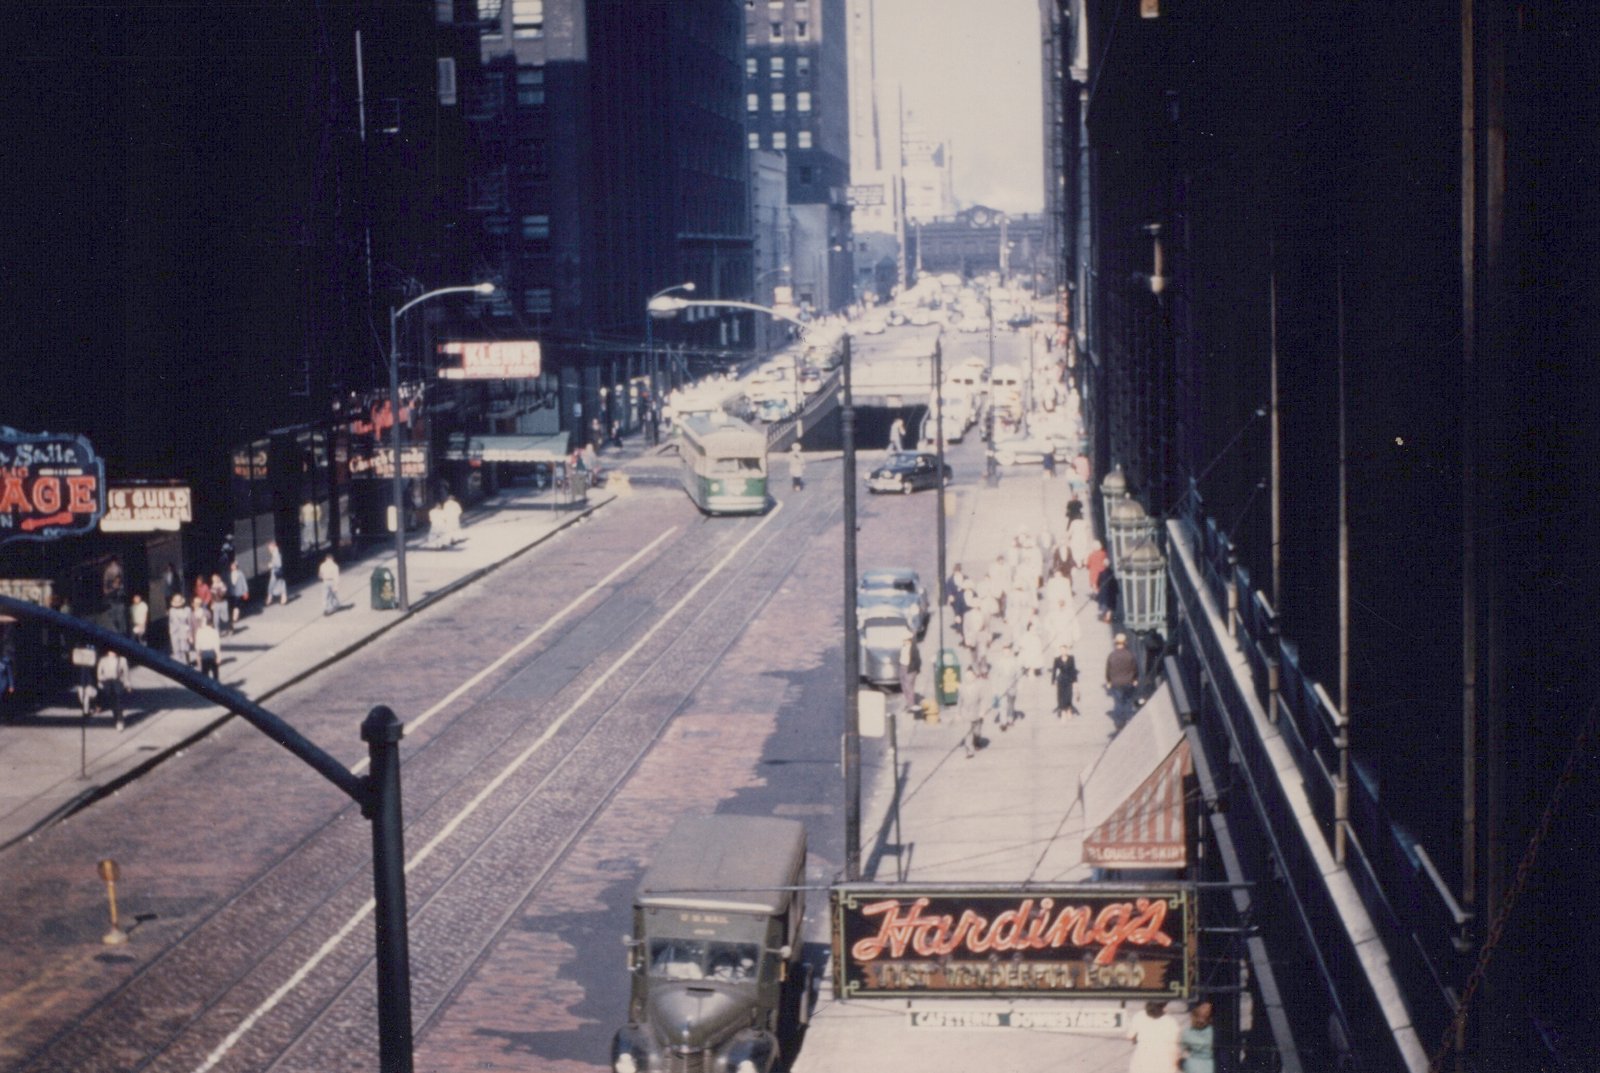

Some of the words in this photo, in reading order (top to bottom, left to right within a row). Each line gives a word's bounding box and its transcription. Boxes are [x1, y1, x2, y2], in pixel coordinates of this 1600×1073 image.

[14, 443, 77, 467] Salle
[133, 489, 188, 508] GUILD
[852, 897, 1172, 965] Harding's
[1085, 963, 1146, 988] FOOD
